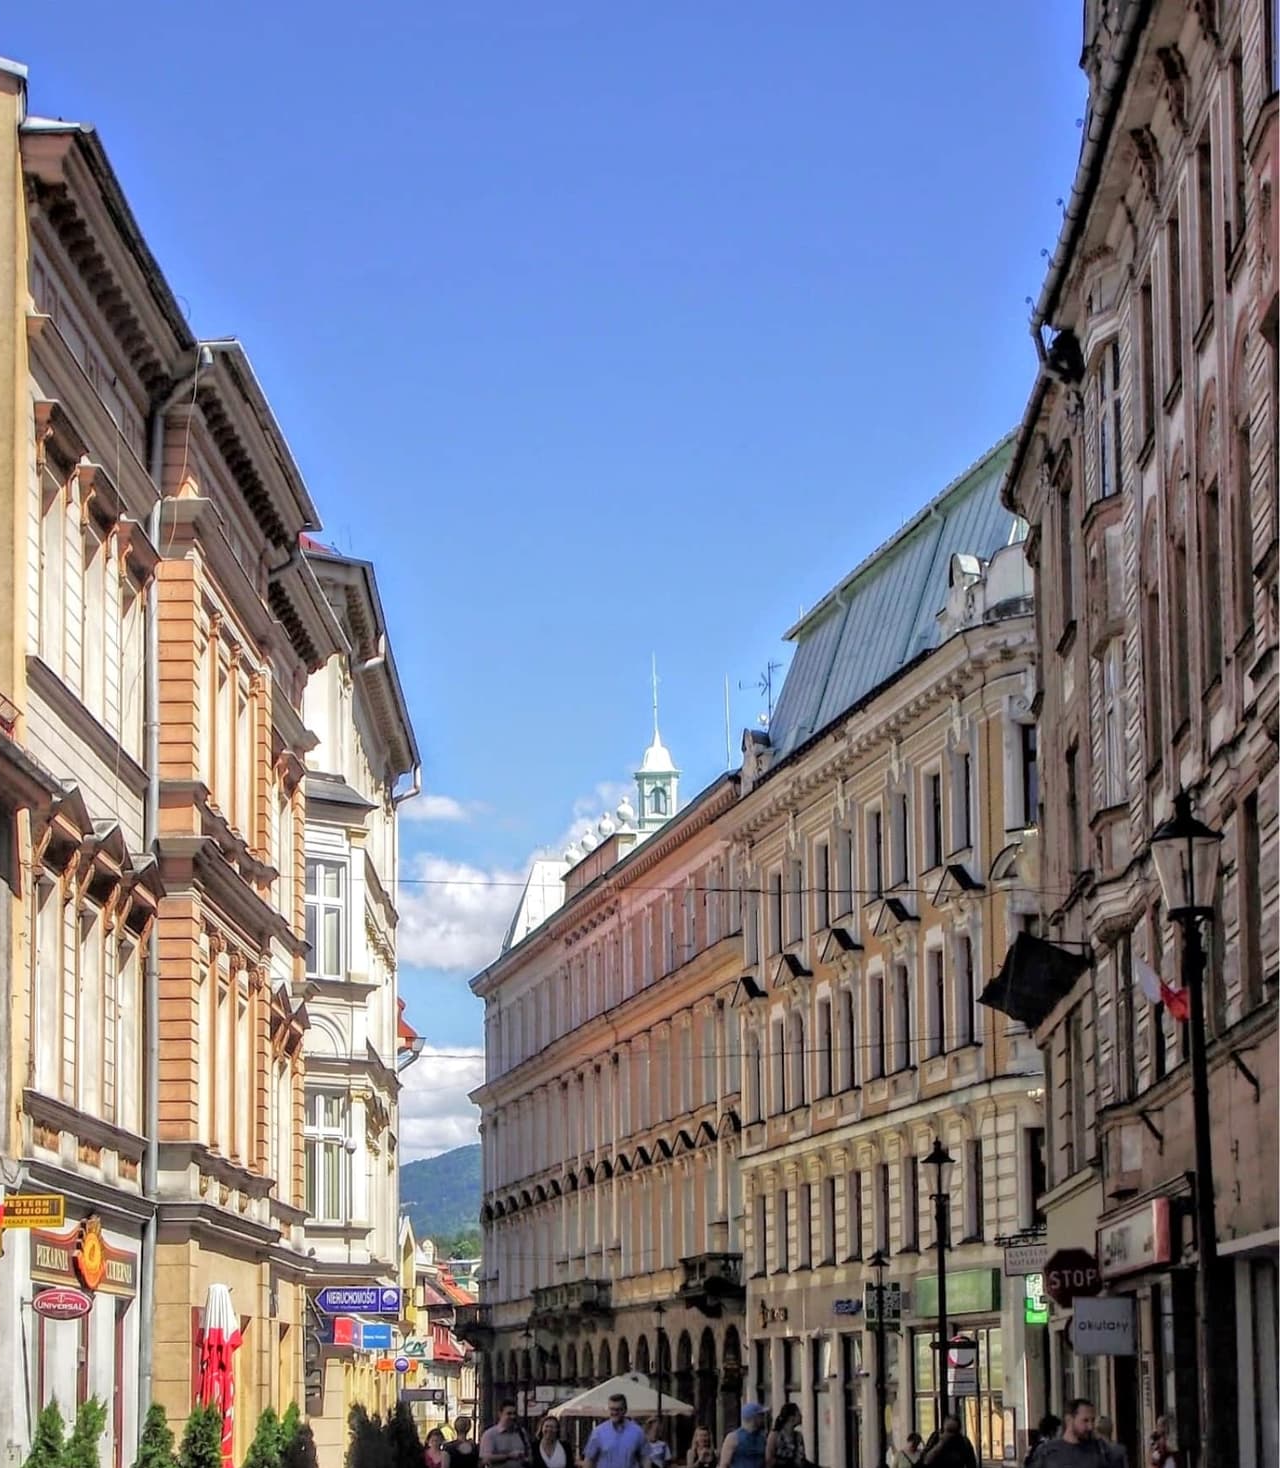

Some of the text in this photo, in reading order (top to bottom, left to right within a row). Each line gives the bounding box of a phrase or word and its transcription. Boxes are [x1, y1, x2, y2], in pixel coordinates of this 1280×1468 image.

[15, 1207, 50, 1215] UNION
[1049, 1268, 1097, 1289] STOP
[37, 1300, 85, 1311] UNIVERSAL
